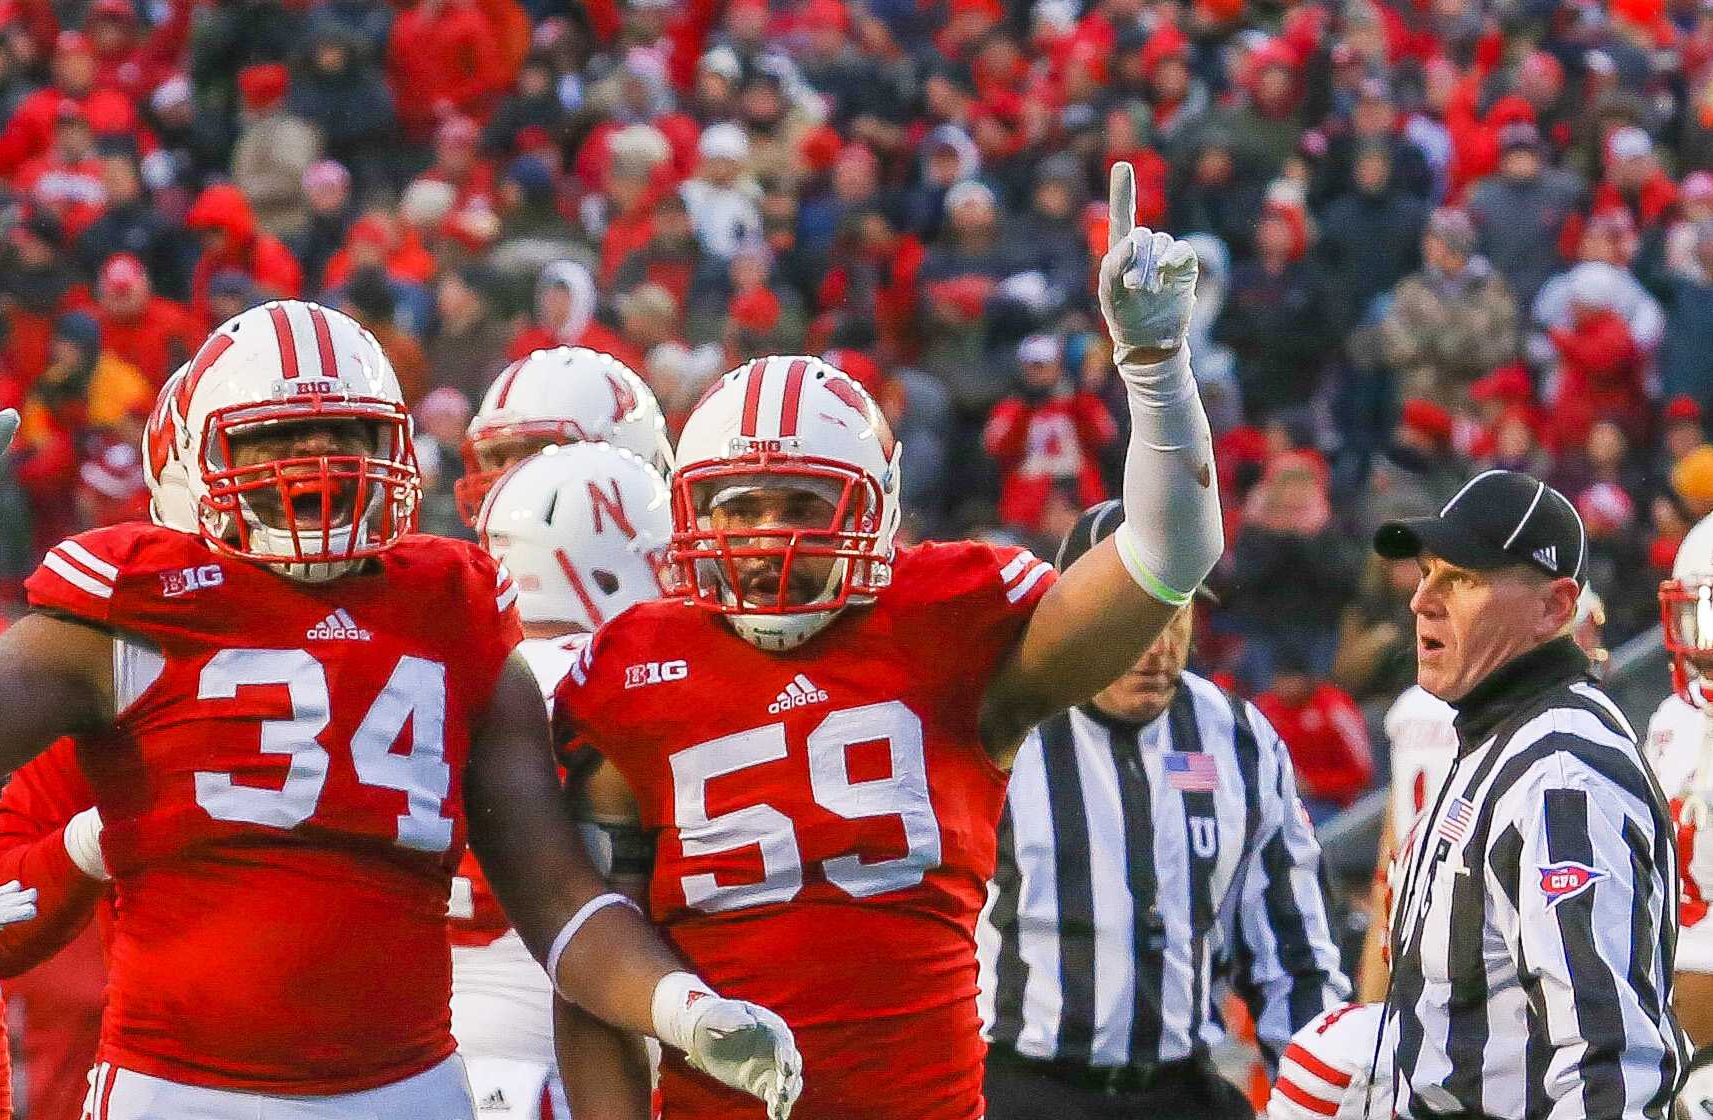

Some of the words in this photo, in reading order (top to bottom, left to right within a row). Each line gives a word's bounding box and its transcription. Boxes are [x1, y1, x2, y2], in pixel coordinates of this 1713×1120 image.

[588, 478, 637, 541] N
[306, 628, 372, 641] adidas
[767, 689, 829, 714] adidas
[194, 649, 454, 852] 34
[669, 700, 942, 913] 59
[1188, 817, 1217, 858] U
